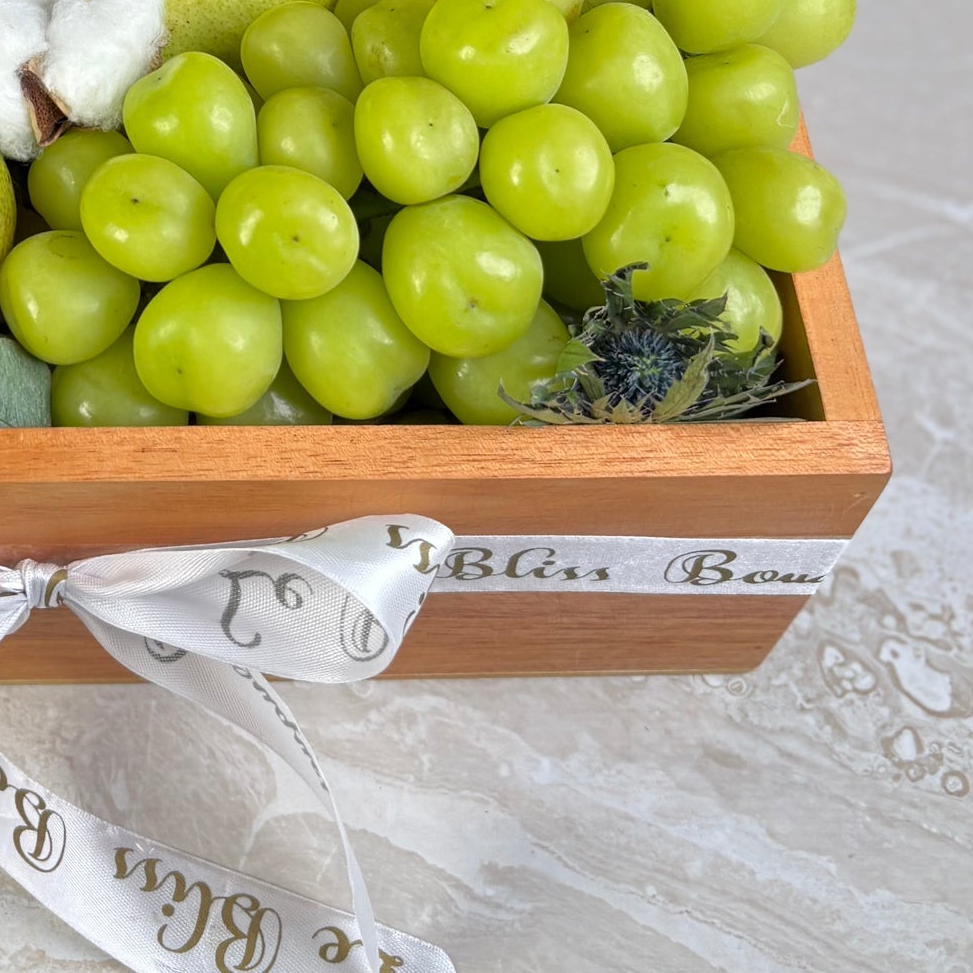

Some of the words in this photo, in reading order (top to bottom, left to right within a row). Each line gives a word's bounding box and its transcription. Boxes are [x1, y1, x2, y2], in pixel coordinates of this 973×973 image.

[435, 546, 611, 581] Bliss
[663, 548, 826, 586] Bou
[112, 846, 283, 973] Bliss
